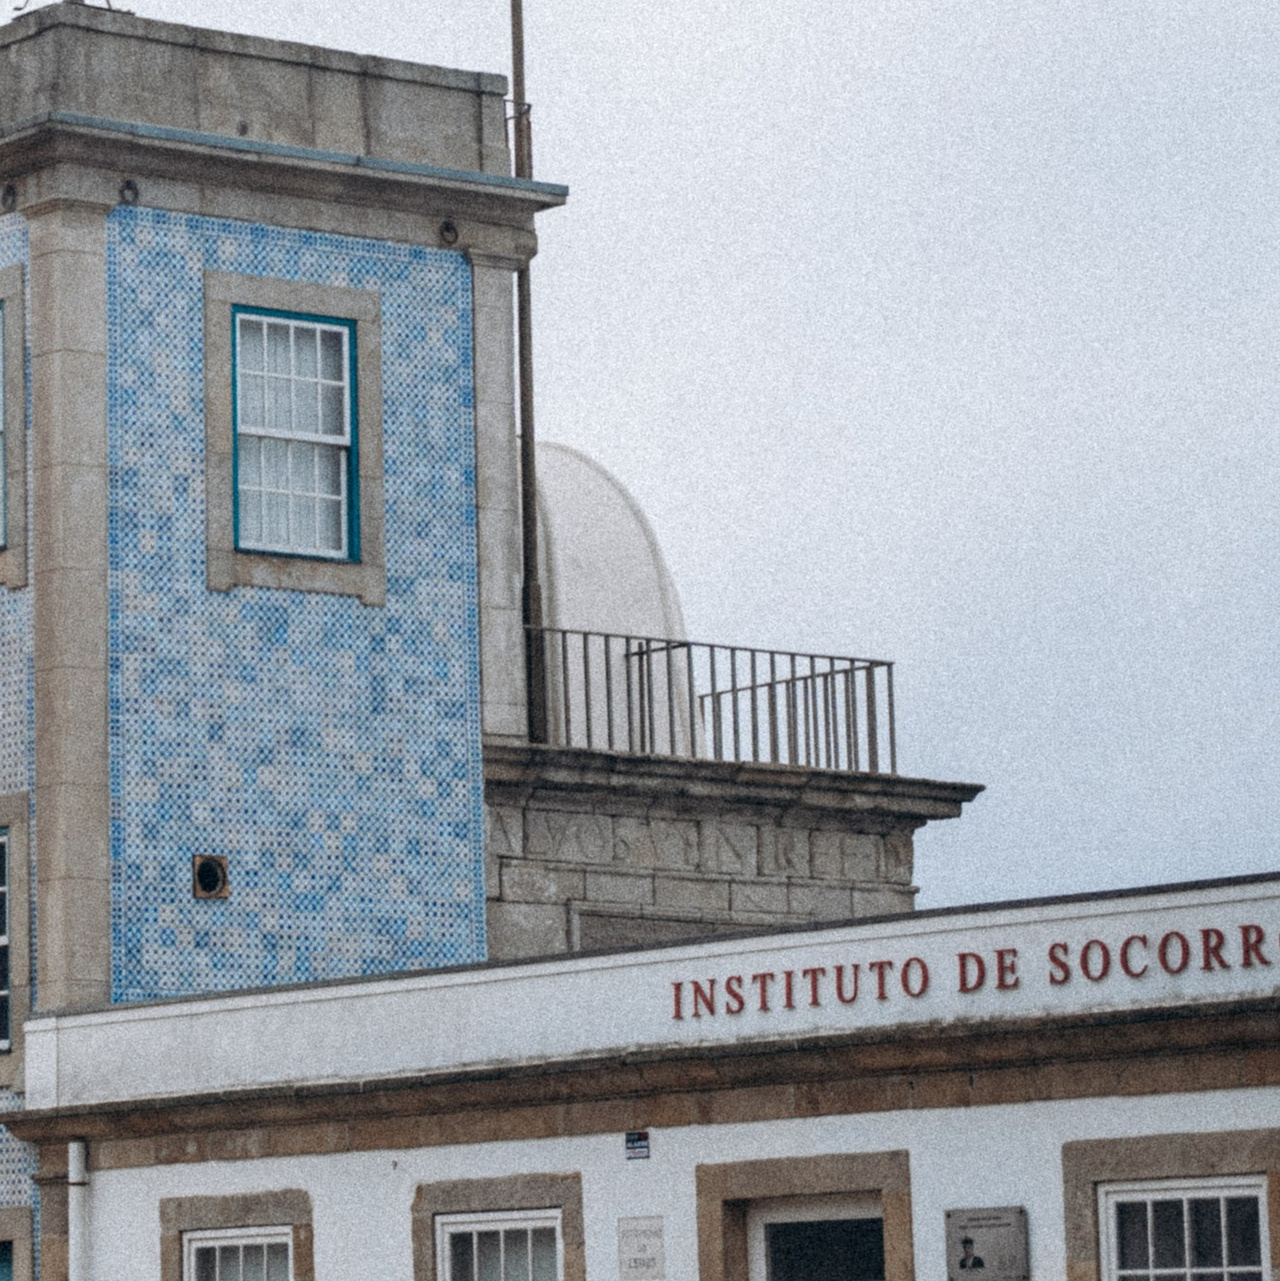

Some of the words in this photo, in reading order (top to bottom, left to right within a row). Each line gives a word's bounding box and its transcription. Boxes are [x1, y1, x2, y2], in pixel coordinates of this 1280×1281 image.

[671, 957, 930, 1021] INSTITUTO
[956, 948, 1021, 994] DE
[1048, 923, 1280, 986] SOCORR
